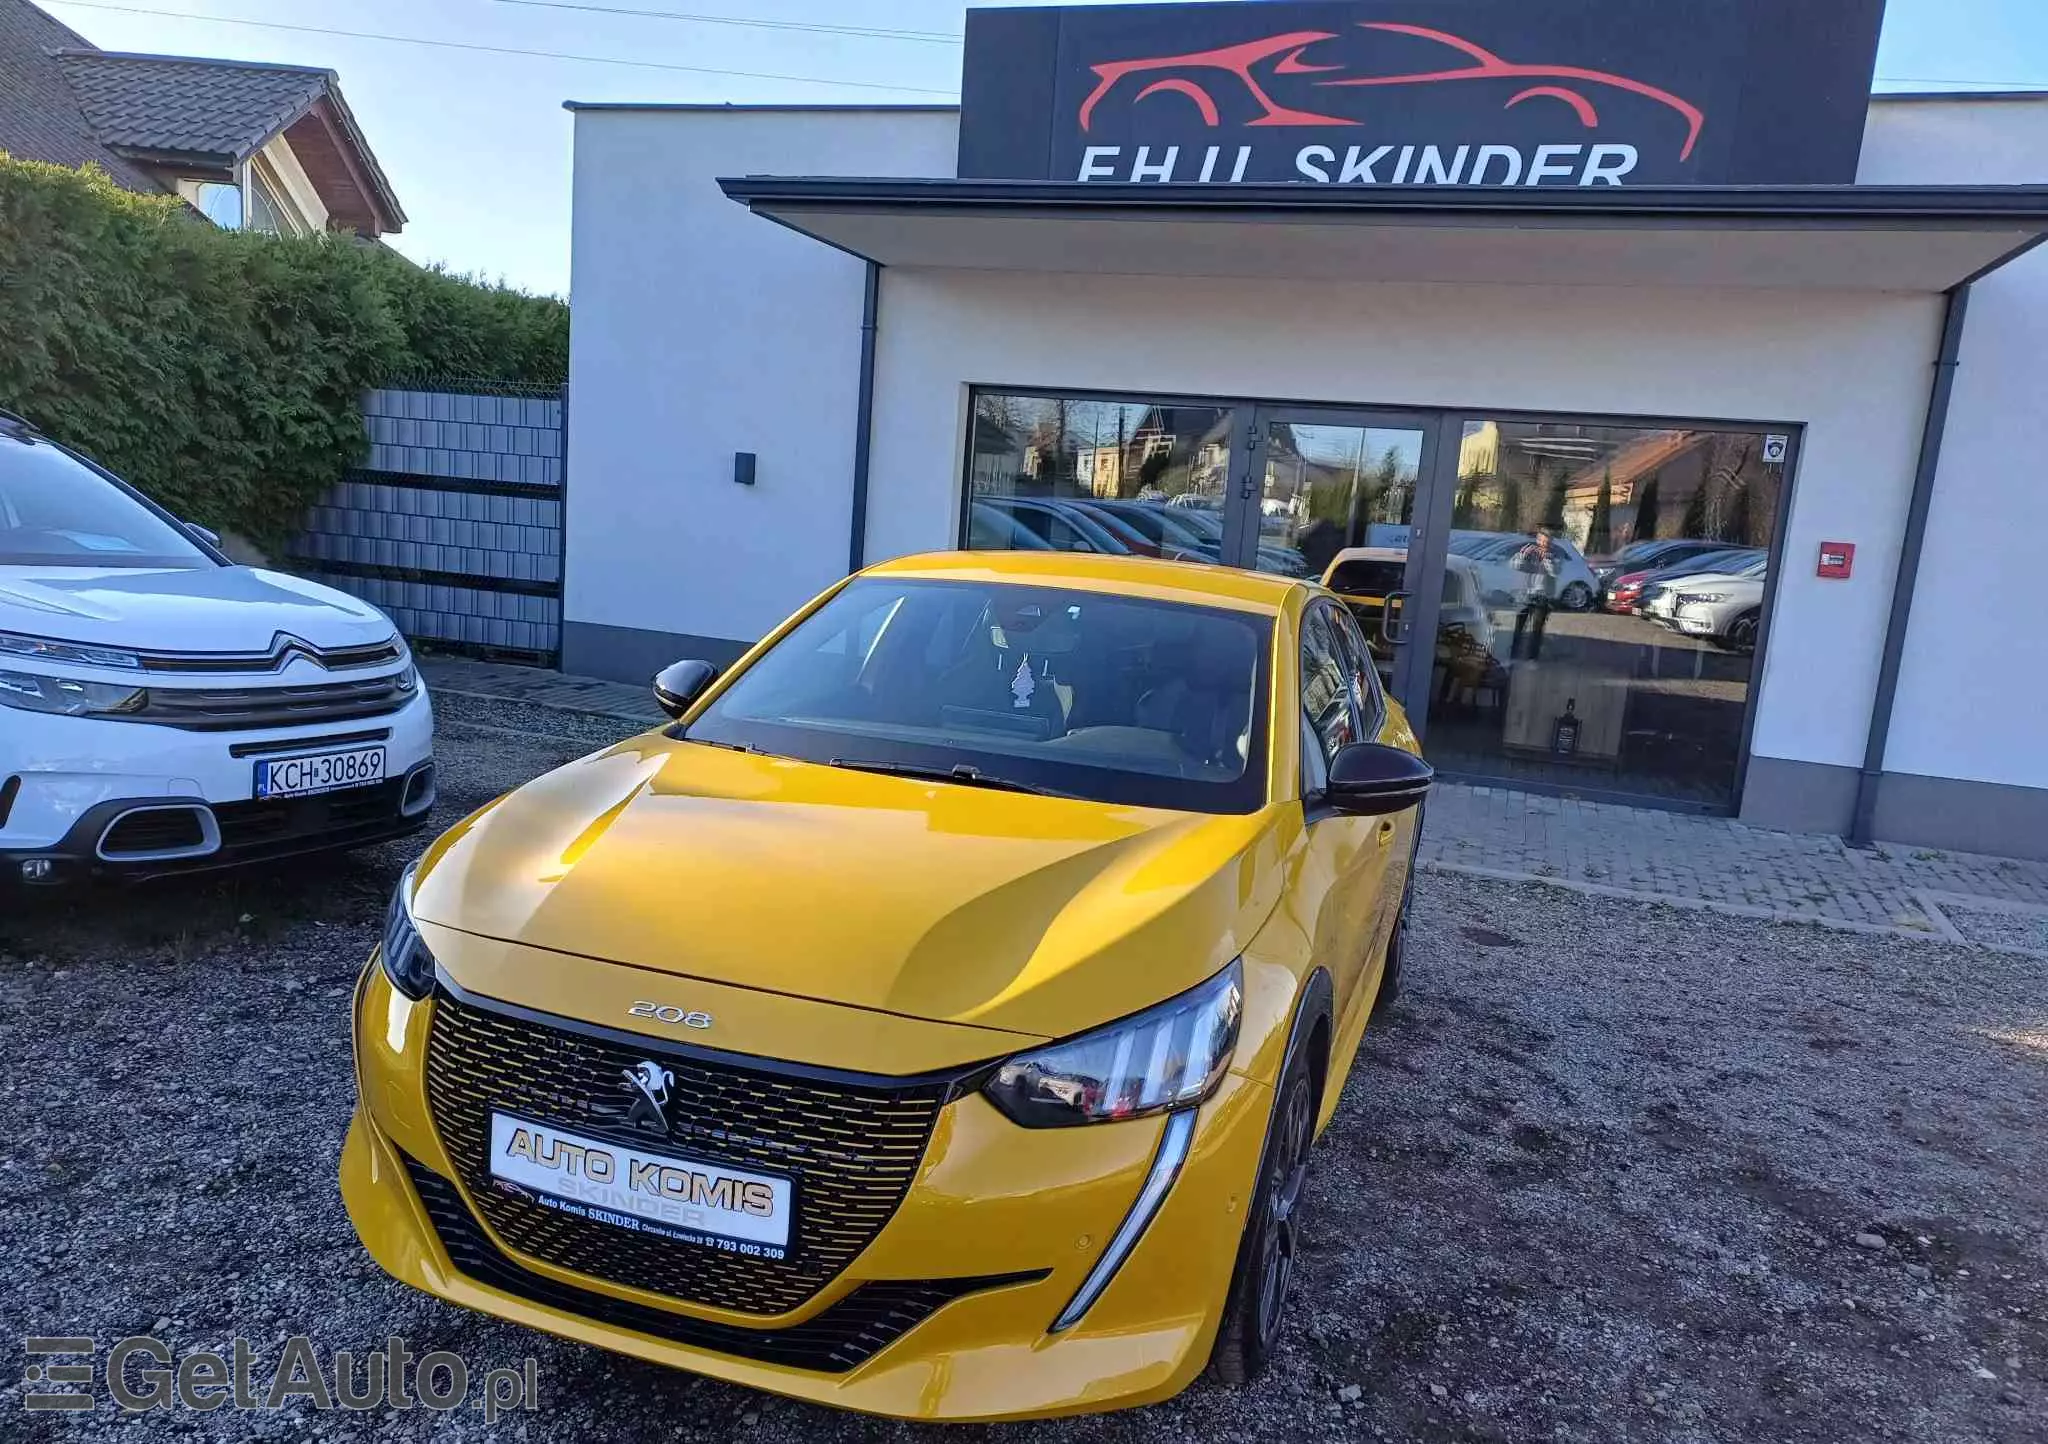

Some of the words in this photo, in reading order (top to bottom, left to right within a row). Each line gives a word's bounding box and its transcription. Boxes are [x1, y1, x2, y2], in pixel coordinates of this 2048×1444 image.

[1288, 144, 1638, 187] SKINDER
[270, 760, 313, 792] KCH
[321, 752, 381, 783] 30869
[628, 1000, 712, 1029] 208
[506, 1128, 616, 1185] AUTO
[629, 1158, 774, 1218] KOMIS
[558, 1177, 704, 1226] SKINDER
[538, 1195, 558, 1209] Auto
[559, 1201, 586, 1216] Komis
[588, 1208, 640, 1231] SKINDER
[716, 1239, 738, 1252] 793
[740, 1244, 761, 1256] 002
[763, 1248, 785, 1260] 309
